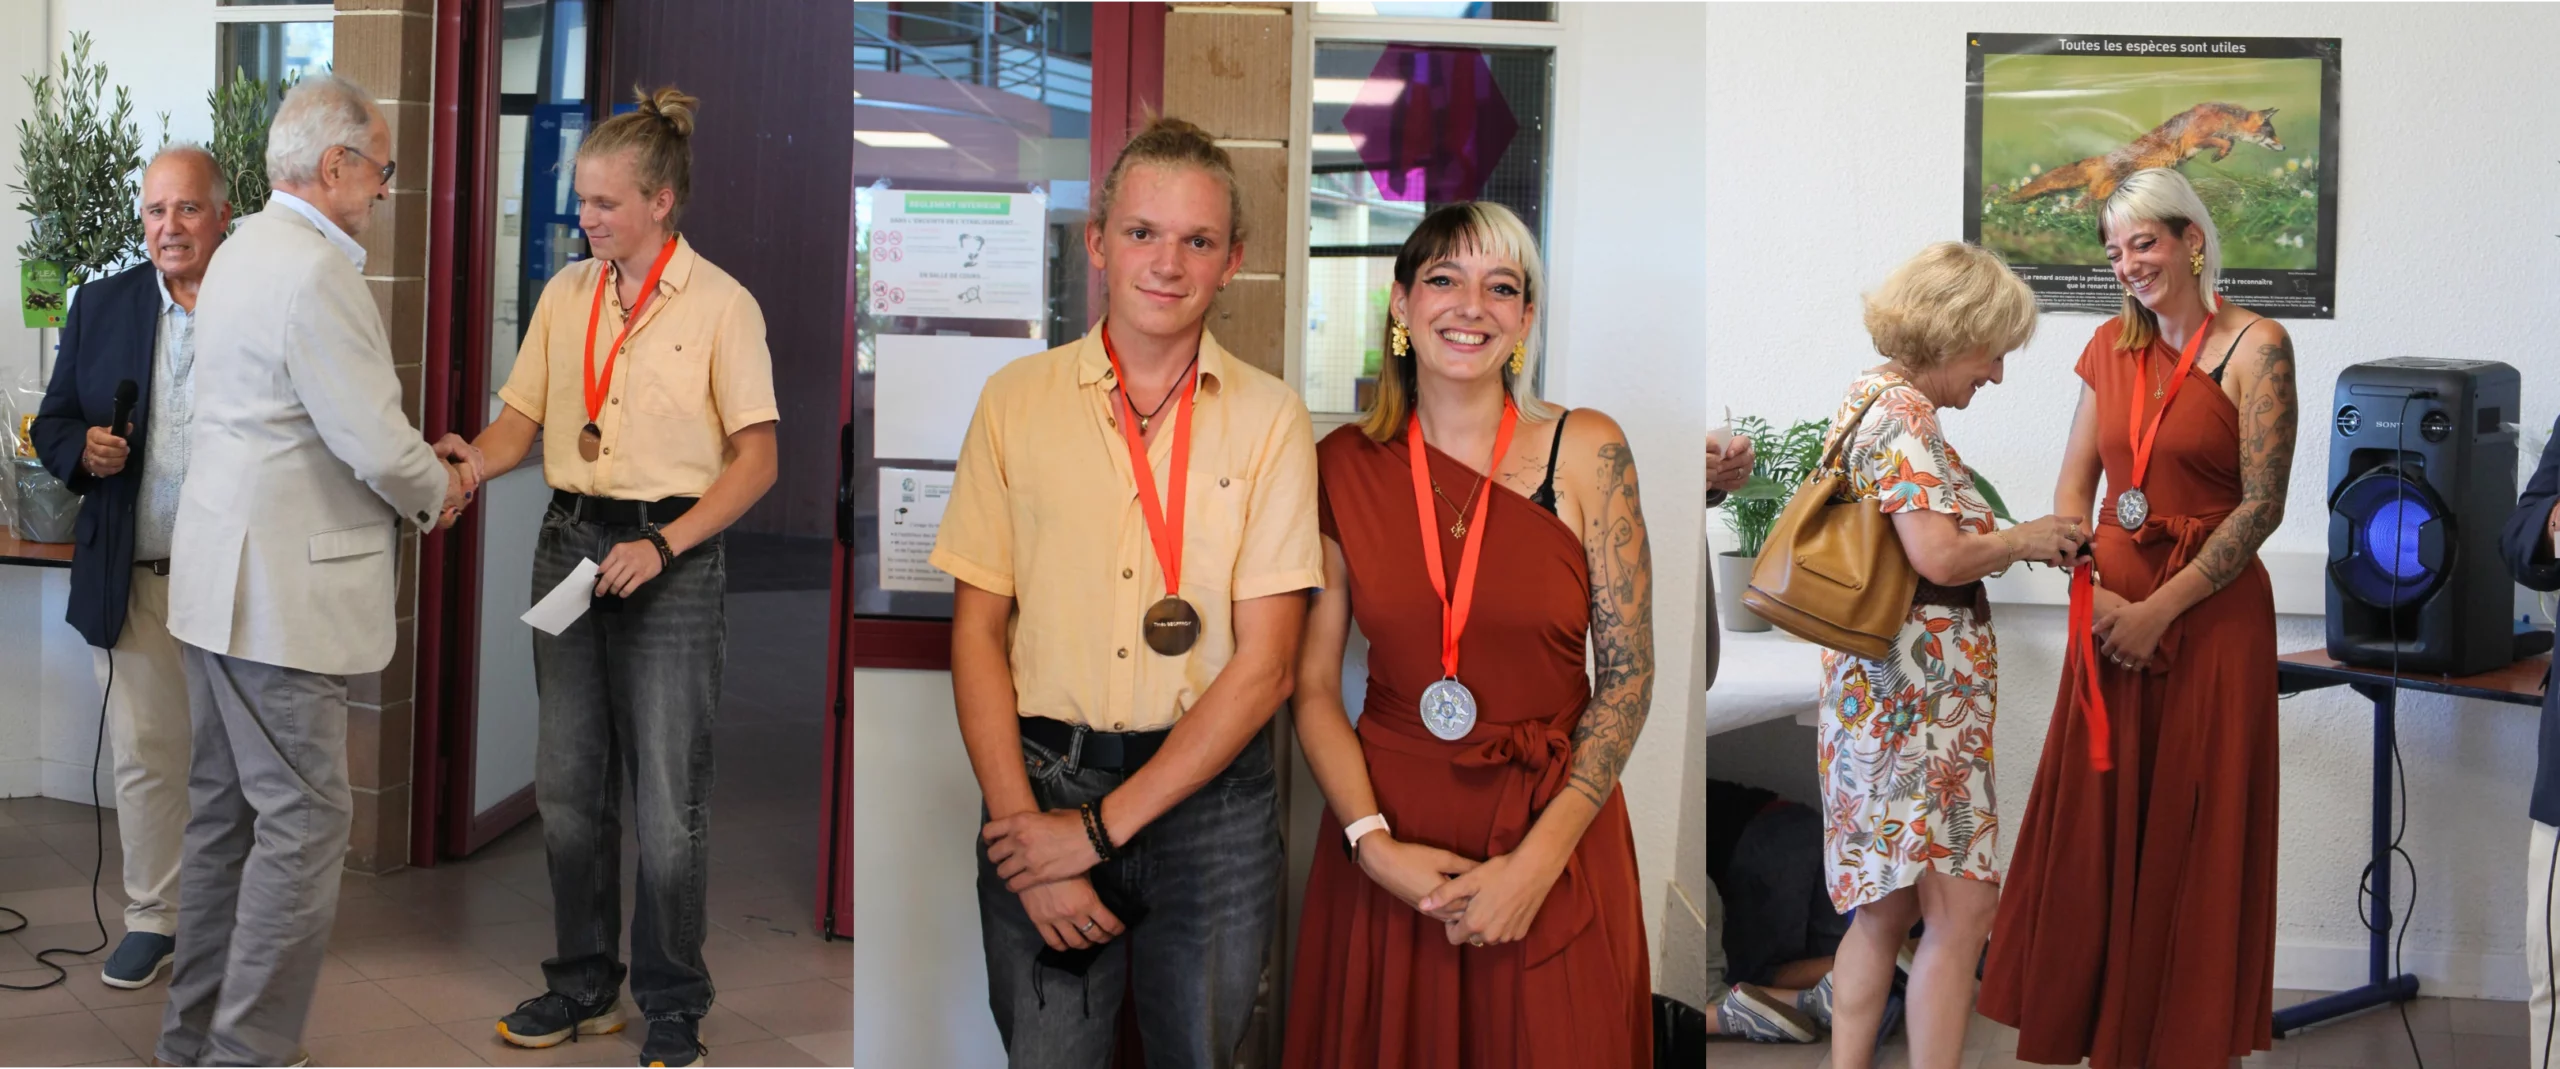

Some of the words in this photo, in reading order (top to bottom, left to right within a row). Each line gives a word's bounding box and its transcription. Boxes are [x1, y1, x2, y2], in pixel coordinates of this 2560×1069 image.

[2058, 38, 2100, 51] Toutes
[2104, 39, 2122, 51] les
[2126, 40, 2177, 55] espèces
[2180, 41, 2207, 53] sont
[2211, 41, 2246, 53] utiles
[2087, 275, 2115, 283] présence
[2237, 278, 2273, 286] reconnaître
